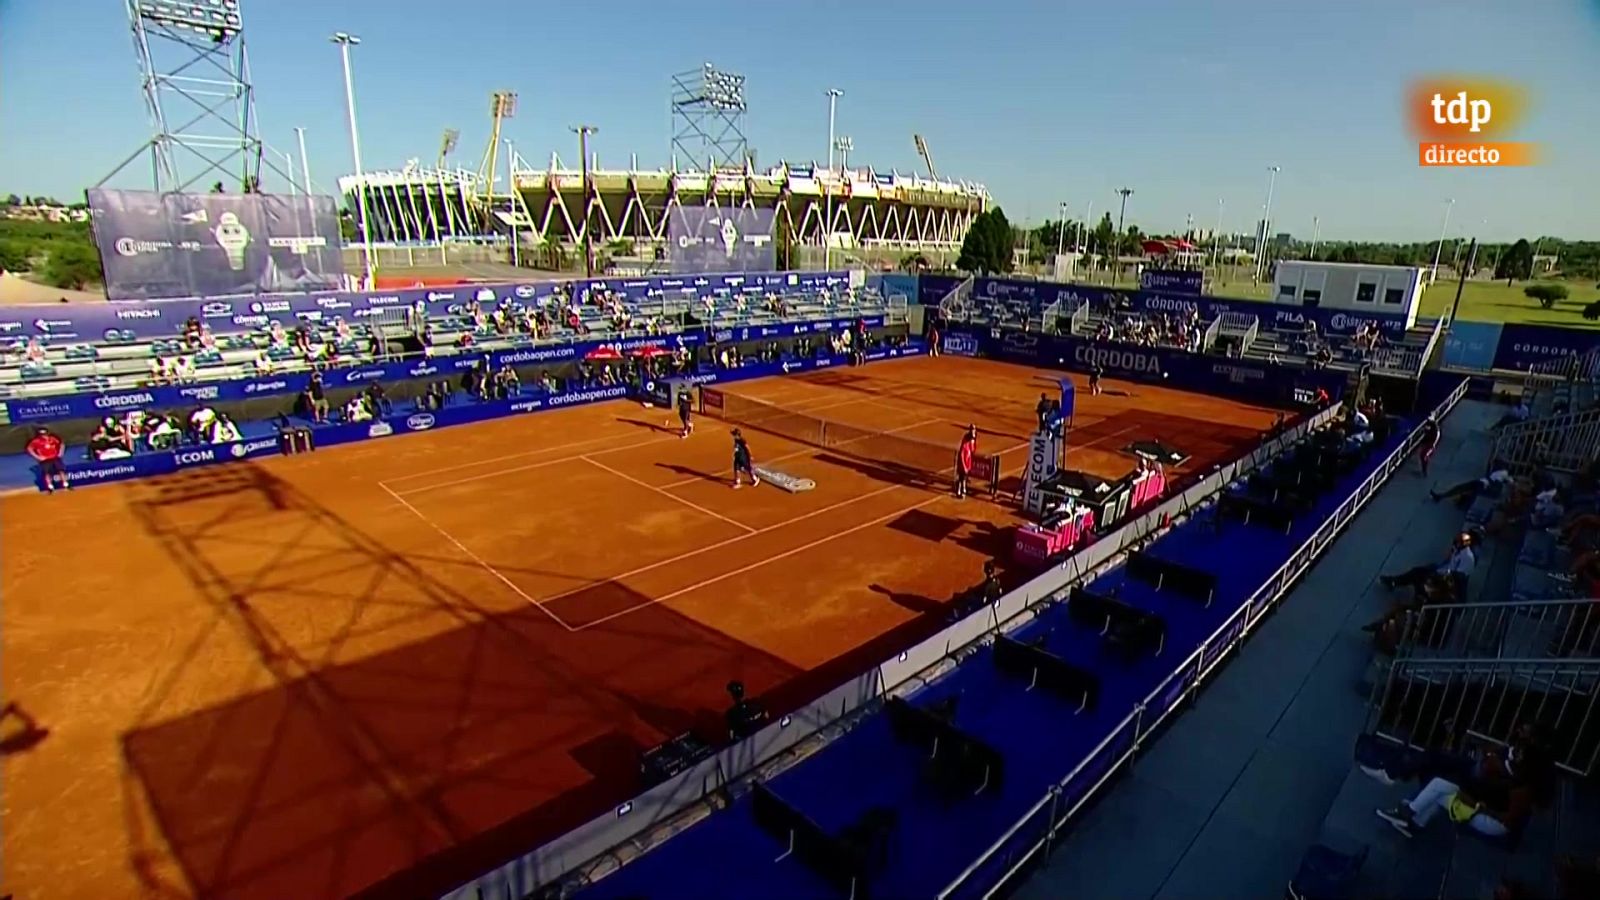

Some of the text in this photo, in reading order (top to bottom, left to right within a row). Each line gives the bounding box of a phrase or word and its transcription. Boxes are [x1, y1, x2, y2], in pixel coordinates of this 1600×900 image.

[1276, 311, 1305, 323] FILA
[499, 346, 575, 364] cordobaopen.com
[1074, 343, 1161, 373] CÓRDOBA
[94, 393, 154, 408] CÓRDOBA
[548, 385, 627, 406] cordobaopen.com
[511, 399, 542, 412] octagon
